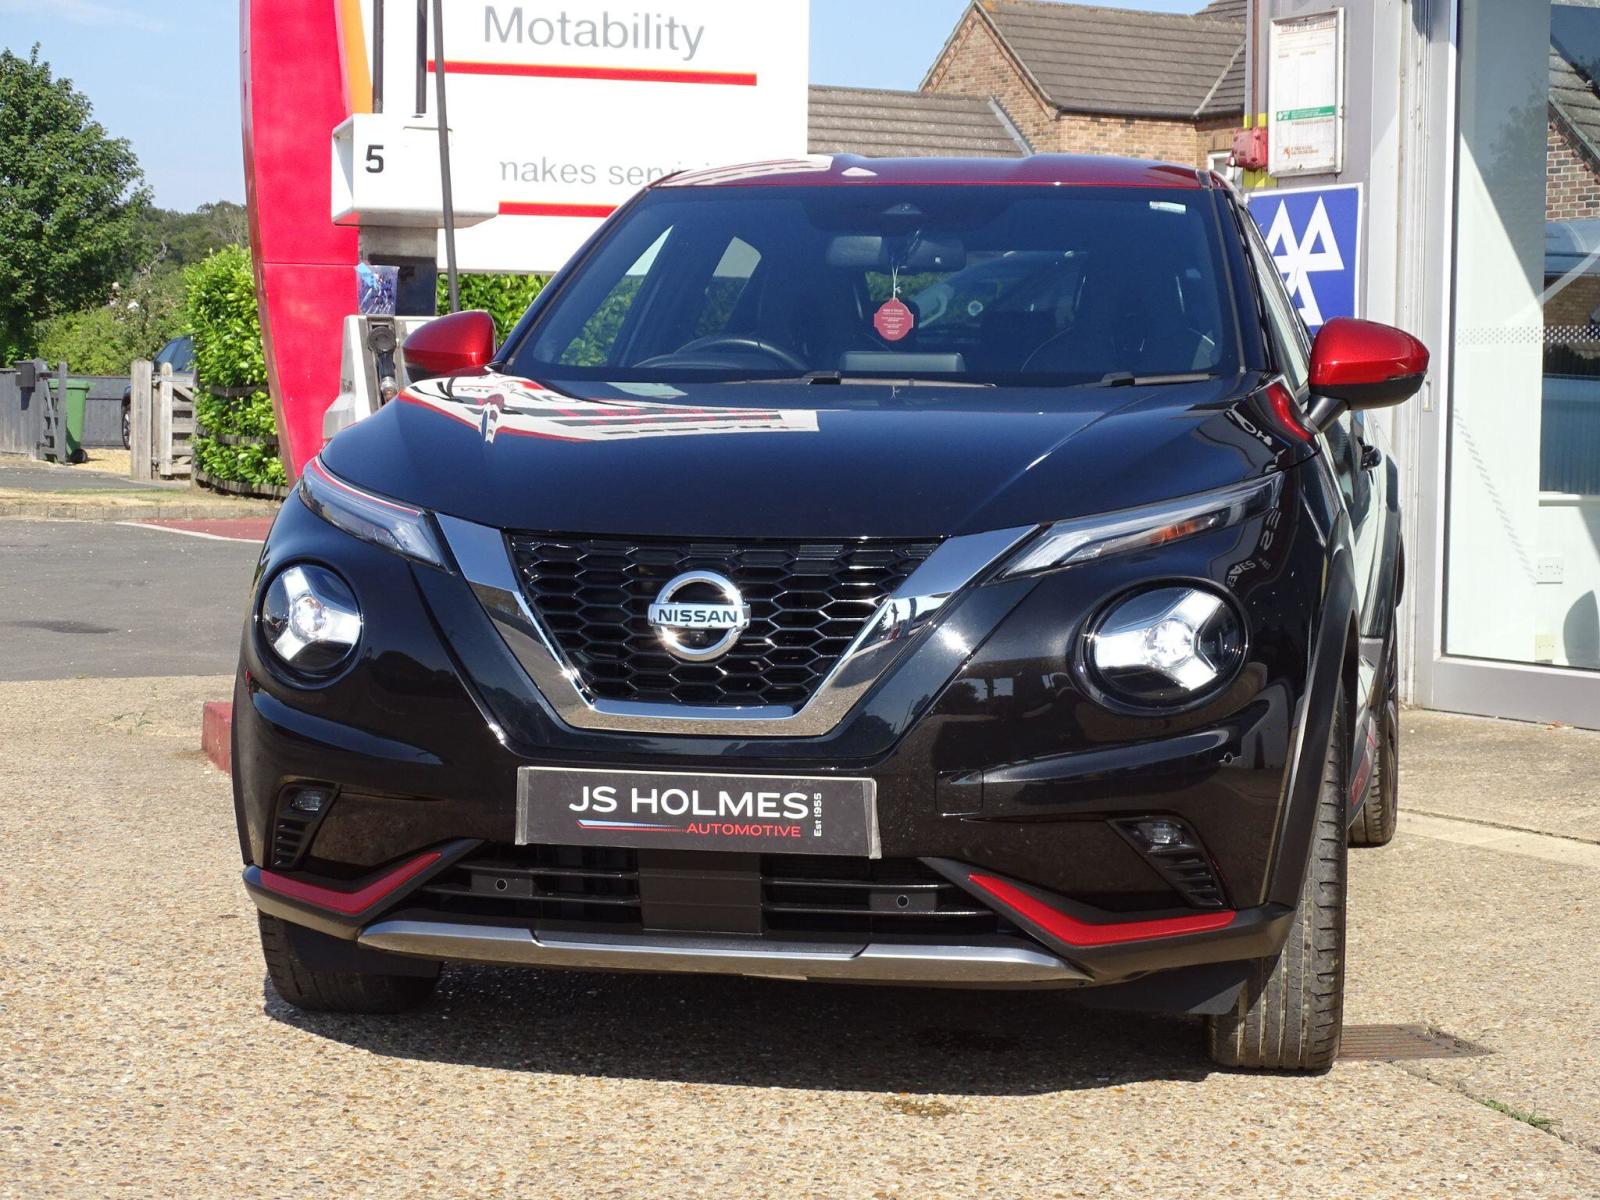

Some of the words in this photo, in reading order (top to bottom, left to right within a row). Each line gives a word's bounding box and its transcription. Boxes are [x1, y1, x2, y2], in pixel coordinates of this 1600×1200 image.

[484, 5, 705, 62] Motability
[365, 144, 384, 174] 5
[658, 608, 738, 623] NISSAN
[568, 785, 618, 813] JS
[631, 787, 809, 820] HOLMES
[813, 792, 822, 818] 1955
[686, 822, 801, 838] AUTOMOTIVE
[813, 820, 822, 837] Est
